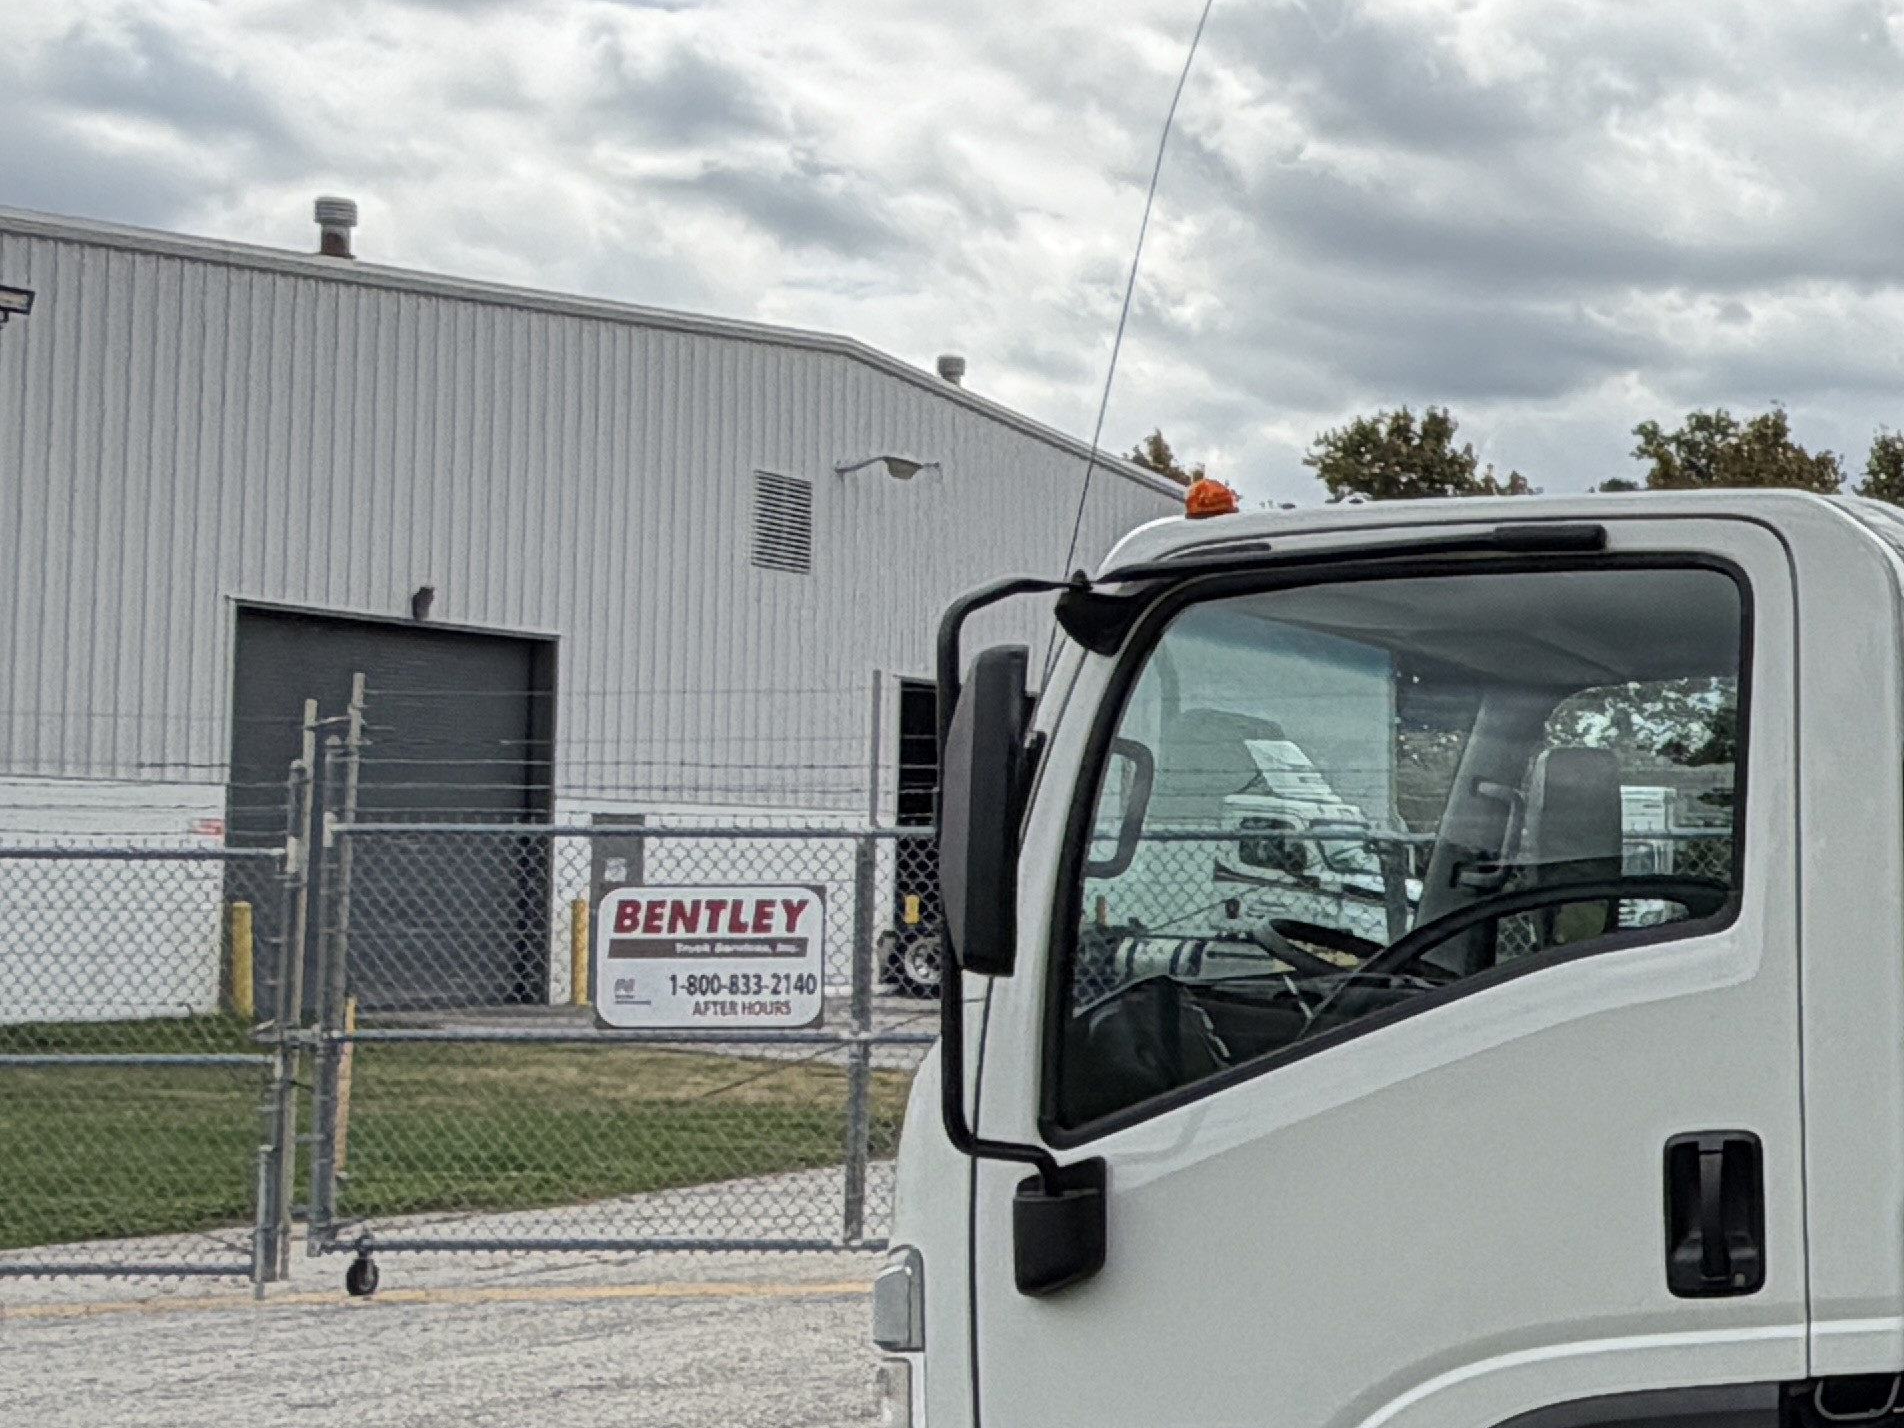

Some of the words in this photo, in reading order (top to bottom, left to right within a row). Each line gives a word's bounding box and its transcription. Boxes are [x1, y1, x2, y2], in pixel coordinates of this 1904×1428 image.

[613, 899, 810, 934] BENTLEY
[669, 973, 818, 996] 1-800-833-2140
[692, 1000, 739, 1016] AFTER
[741, 1000, 792, 1016] HOURS
